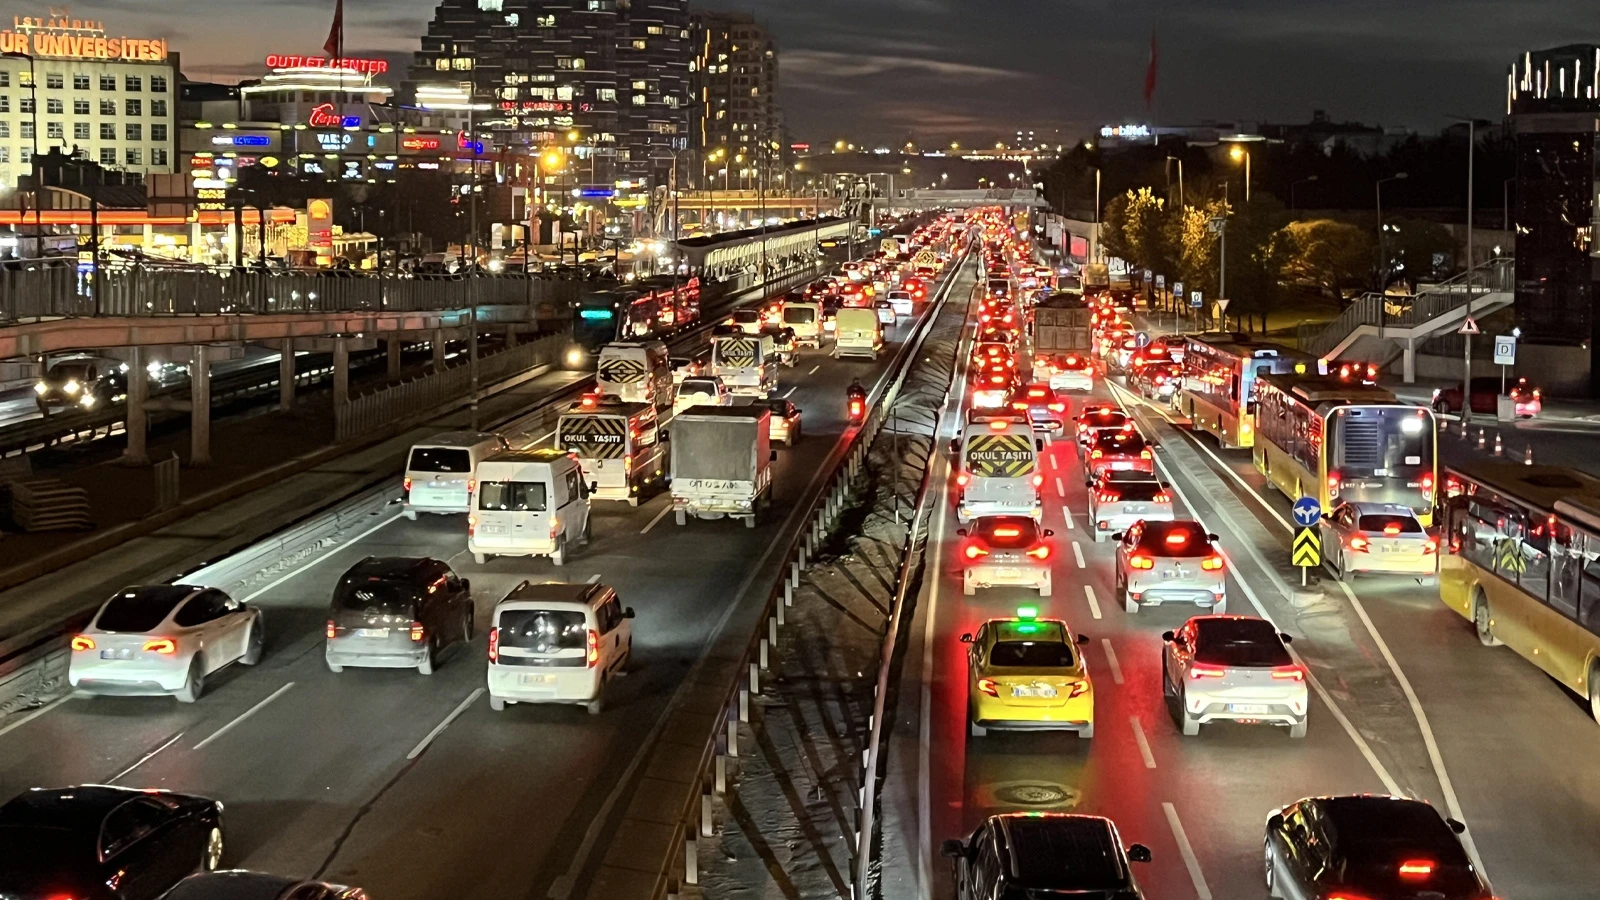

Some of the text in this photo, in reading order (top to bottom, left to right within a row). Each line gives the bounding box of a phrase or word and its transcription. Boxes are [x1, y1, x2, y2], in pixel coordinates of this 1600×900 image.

[266, 55, 388, 73] OUTLET CENTER
[1501, 345, 1509, 354] D
[564, 434, 588, 442] OKUL
[970, 451, 998, 460] OKUL
